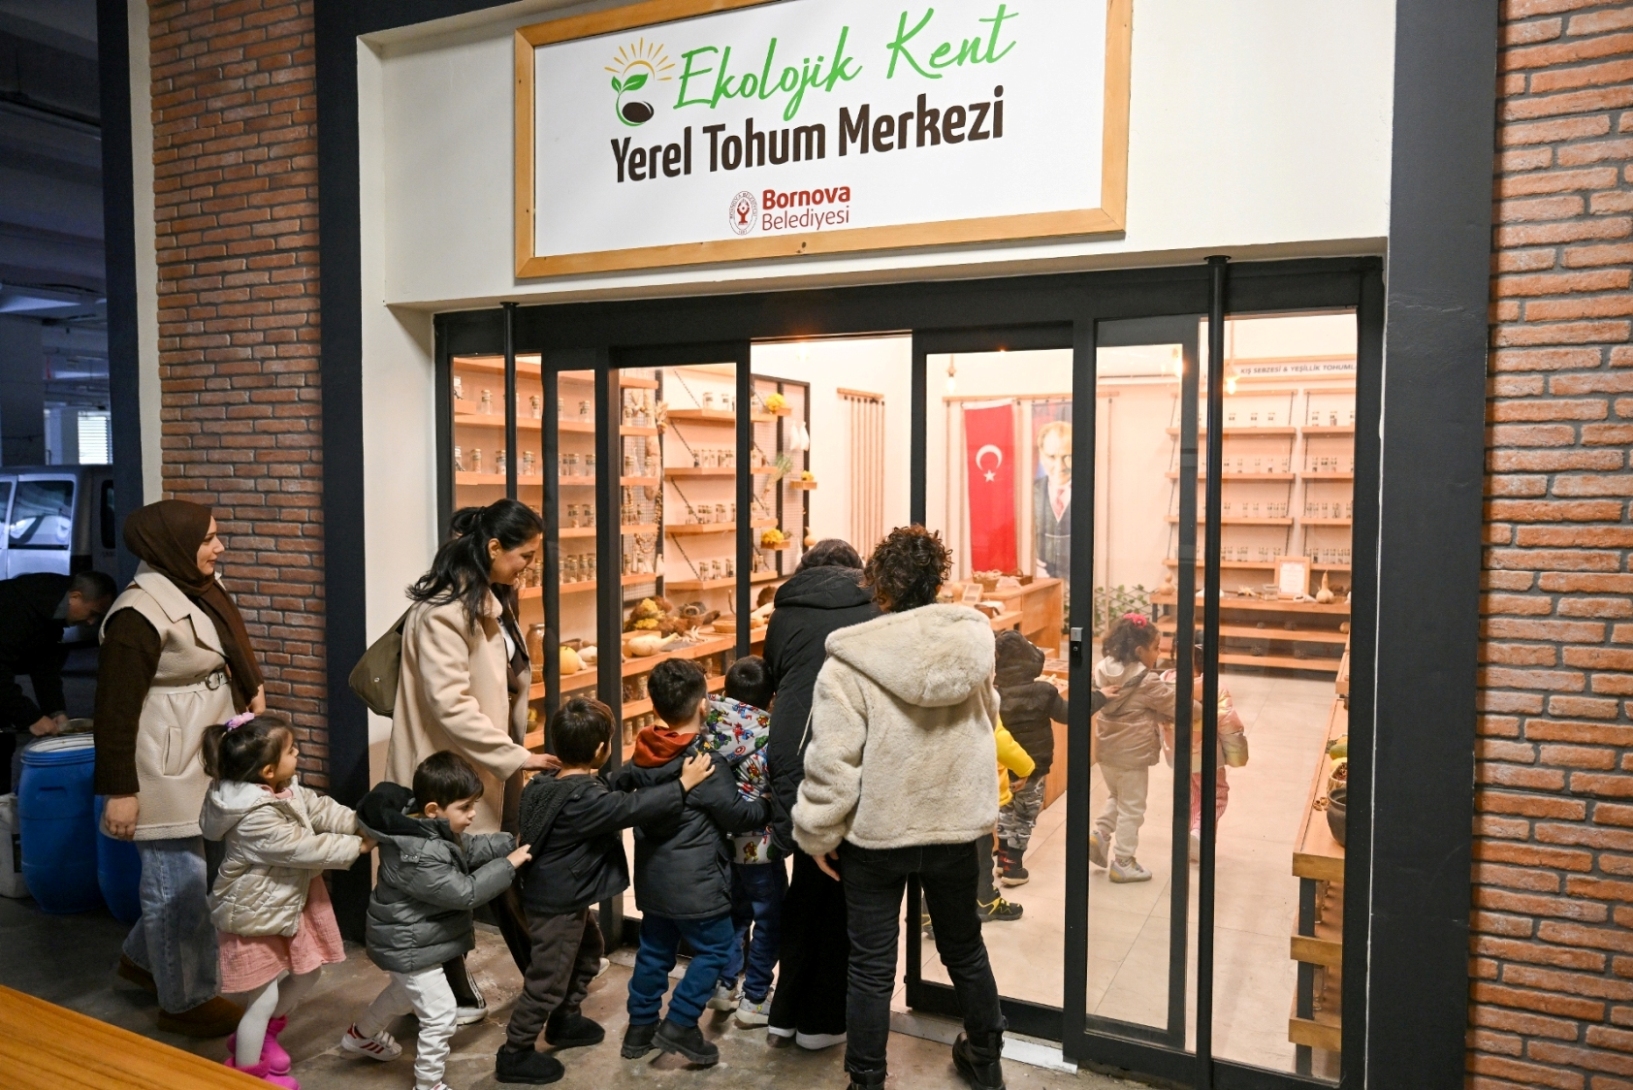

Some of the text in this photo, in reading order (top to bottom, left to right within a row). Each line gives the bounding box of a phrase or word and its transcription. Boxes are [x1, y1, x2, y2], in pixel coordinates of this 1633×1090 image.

[673, 4, 1019, 121] Ekolojik Kent
[611, 85, 1004, 183] Yerel Tohum Merkezi
[762, 186, 851, 211] Bornova
[762, 205, 850, 231] Belediyesi
